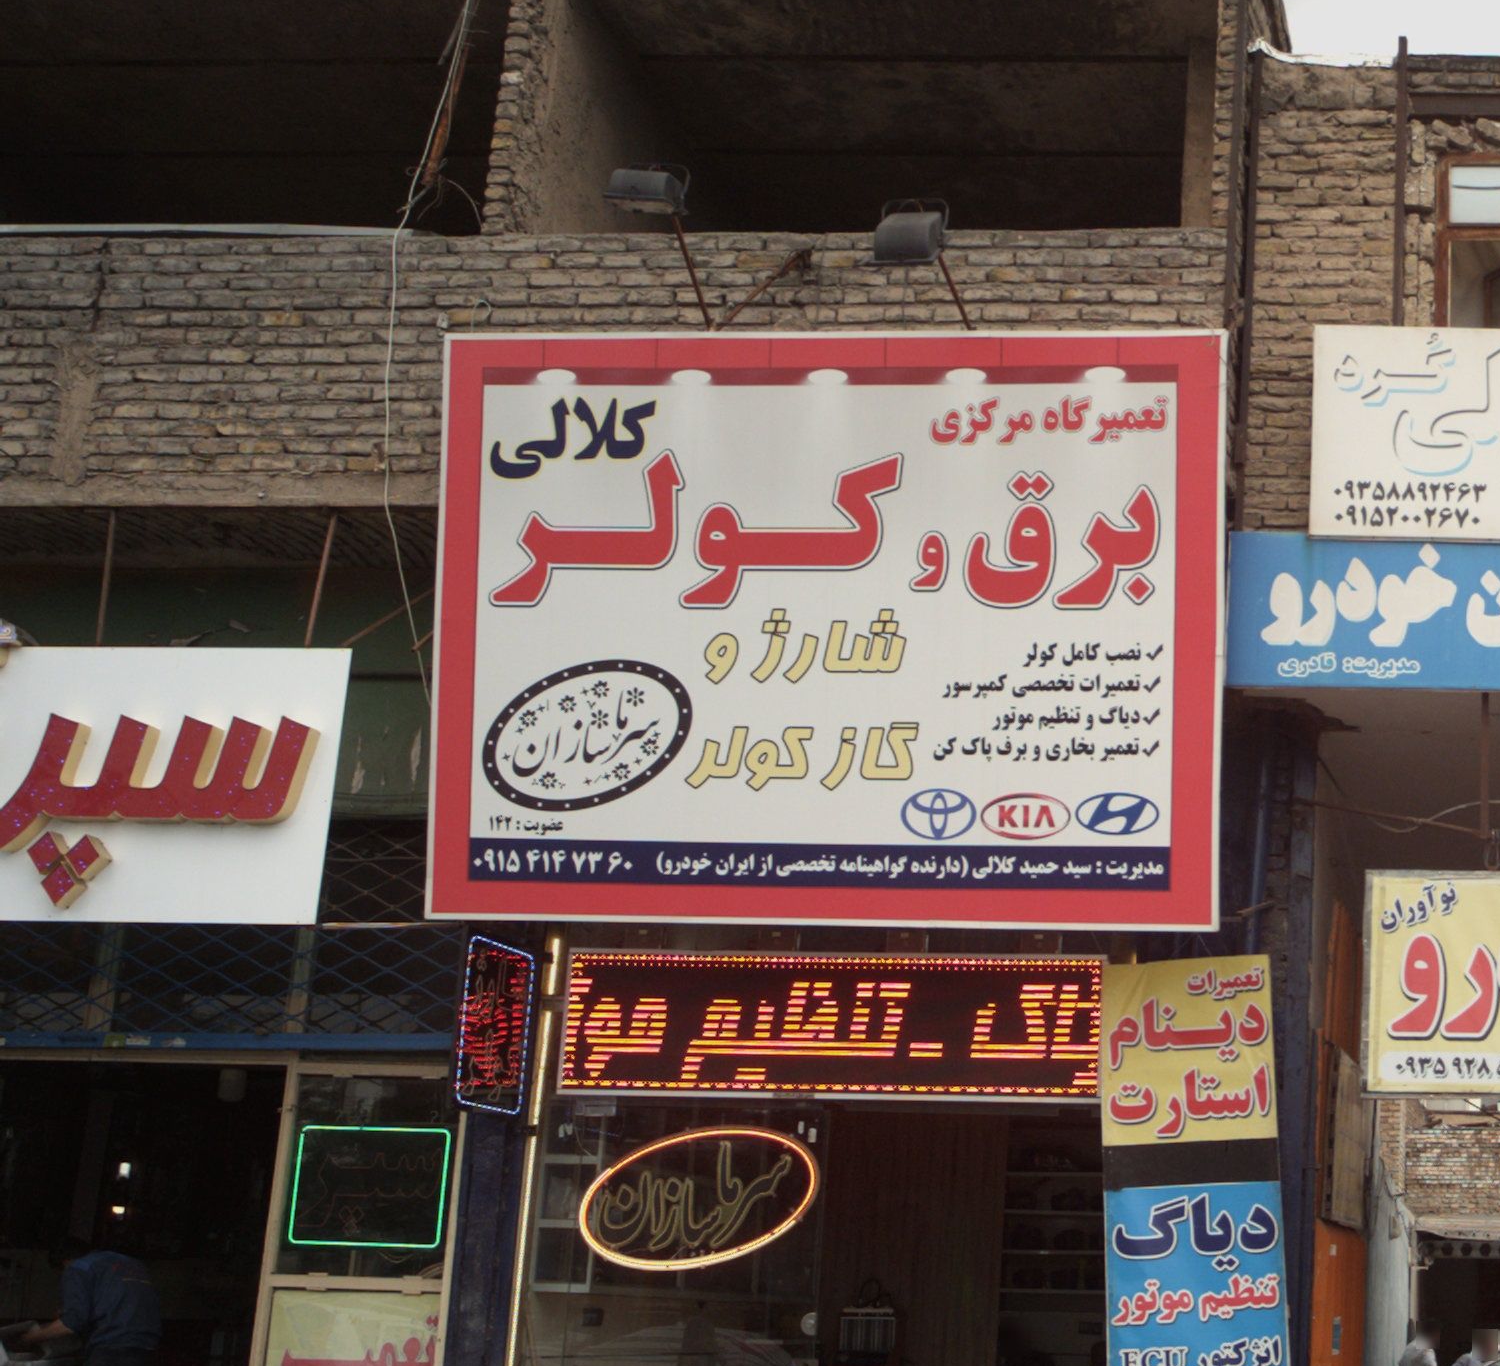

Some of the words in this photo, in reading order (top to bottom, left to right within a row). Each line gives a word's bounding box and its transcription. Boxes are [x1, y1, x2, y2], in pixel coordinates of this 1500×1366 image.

[930, 395, 1036, 444] مرکزی
[489, 396, 658, 480] کلالی
[488, 449, 905, 611] کولر
[962, 470, 1161, 611] برق
[908, 530, 950, 592] و
[1260, 544, 1459, 646] خودرو
[703, 632, 740, 685] و
[751, 608, 907, 684] شارژ
[1022, 641, 1058, 668] کولر
[1062, 642, 1101, 667] کامل
[1105, 642, 1142, 667] نصب
[1277, 652, 1337, 678] قادری
[942, 673, 1008, 699] کمپرسور
[1012, 674, 1076, 699] تخصصی
[1079, 674, 1141, 699] تعمیرات
[992, 706, 1035, 731] موتور
[1038, 705, 1081, 730] تنظیم
[1084, 714, 1094, 731] و
[1098, 705, 1141, 730] دیاگ
[685, 725, 815, 791] کولر
[819, 721, 920, 791] گاز
[933, 737, 957, 762] کن
[961, 737, 992, 763] پاک
[996, 736, 1028, 763] برف
[1031, 745, 1041, 763] و
[1045, 737, 1096, 762] بخاری
[1099, 737, 1140, 762] تعمیر
[997, 804, 1056, 829] KIA
[714, 852, 756, 876] ایران
[757, 853, 773, 877] از
[775, 853, 836, 878] تخصصی
[839, 853, 908, 879] گواهینامه
[972, 855, 1014, 878] کلالی
[1019, 856, 1058, 879] حمید
[1062, 858, 1092, 878] سید
[1379, 882, 1458, 933] نوآوران
[1186, 966, 1265, 1001] تعمیرات
[1109, 996, 1269, 1071] دینام
[1109, 1062, 1271, 1139] استارت
[1112, 1192, 1280, 1271] دیاگ
[1110, 1278, 1194, 1327] موتور
[1198, 1272, 1280, 1322] تنظیم
